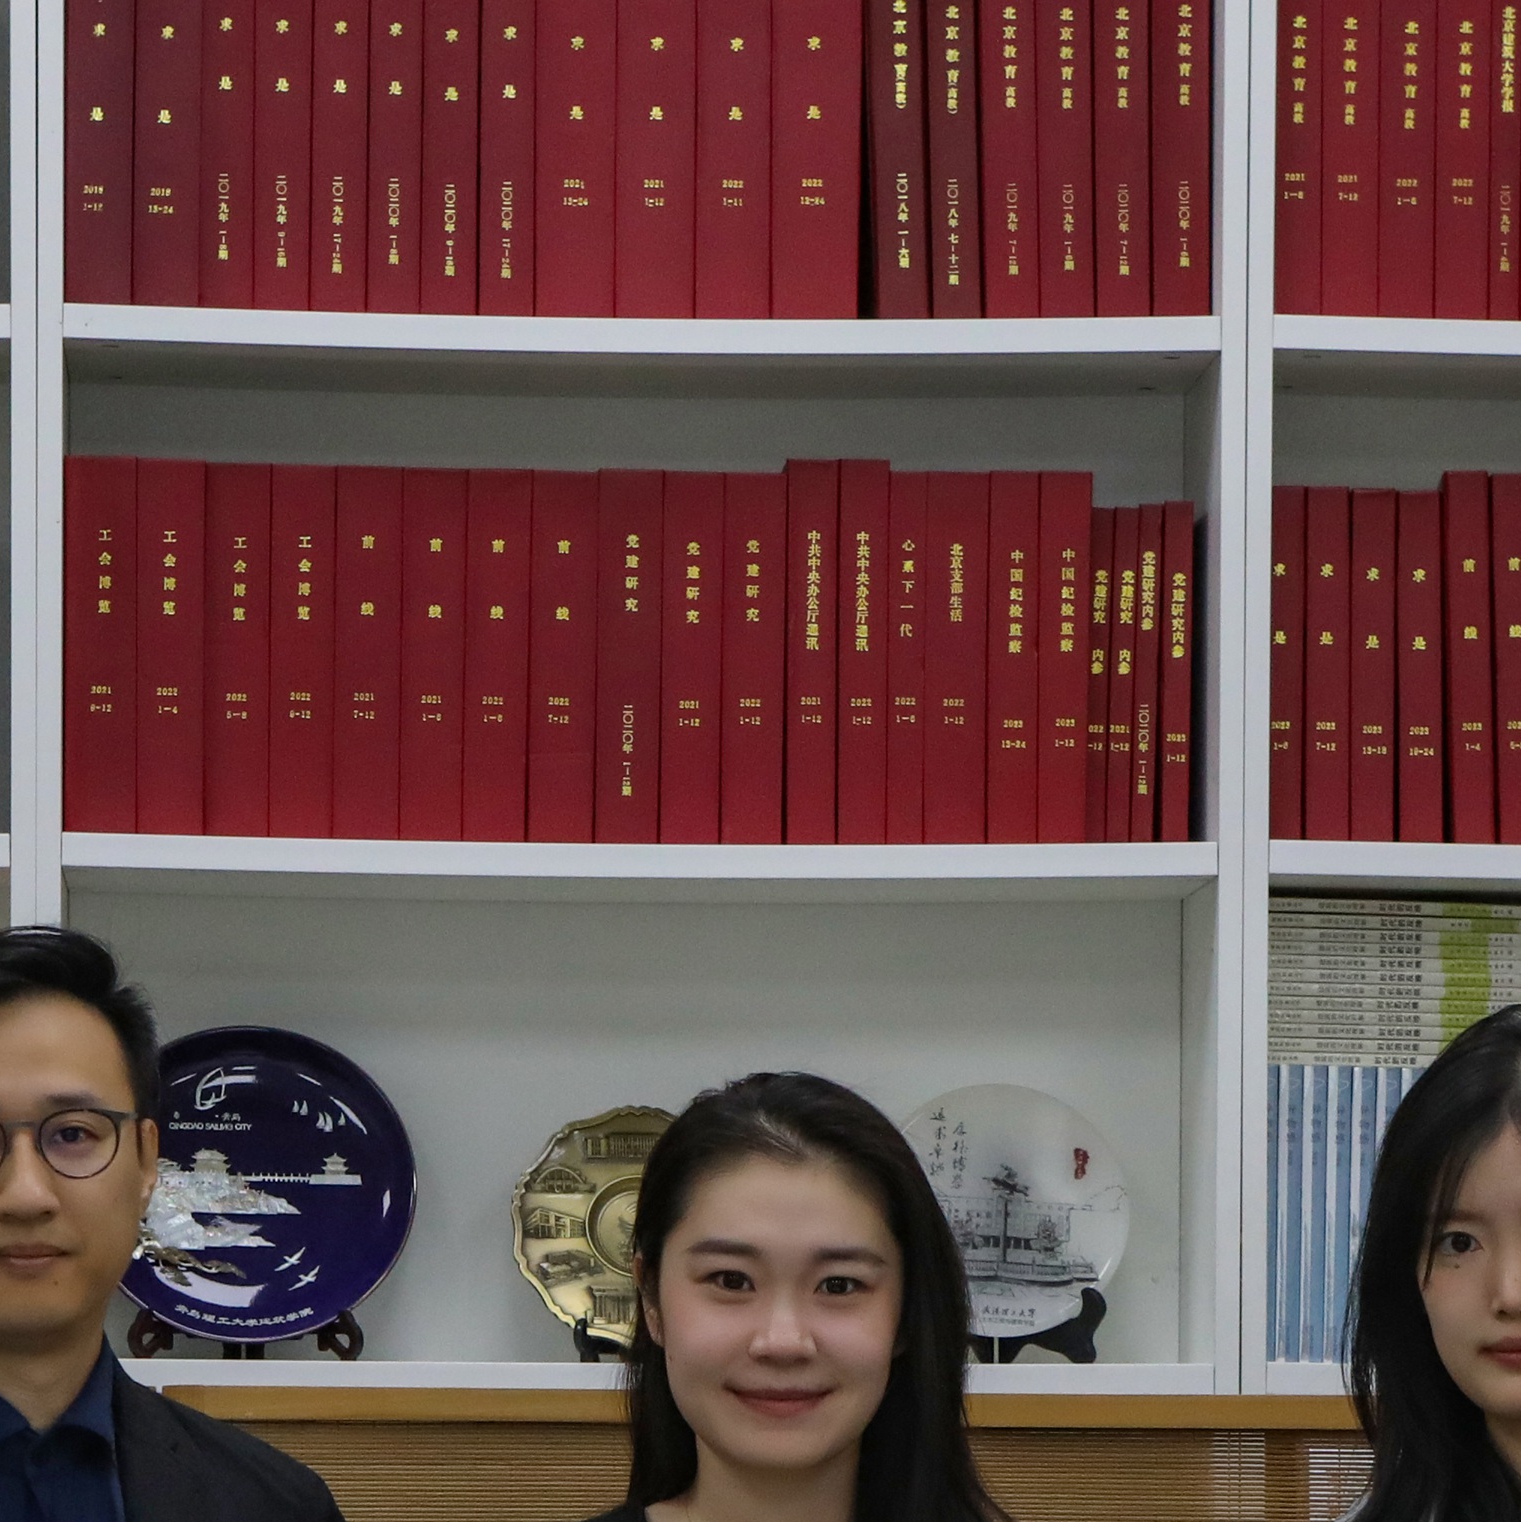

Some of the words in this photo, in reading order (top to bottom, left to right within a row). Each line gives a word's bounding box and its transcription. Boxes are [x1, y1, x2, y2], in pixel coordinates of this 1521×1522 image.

[89, 23, 106, 122] 求是
[157, 25, 175, 124] 求是
[218, 17, 233, 90] 求是
[275, 19, 290, 93] 求是
[502, 25, 517, 99] 求是
[569, 35, 585, 120] 求是
[806, 36, 822, 120] 求是
[801, 178, 823, 188] 2022
[97, 529, 112, 614] 工会博览
[162, 530, 177, 616] 工会博览
[232, 536, 248, 621] 工会博览
[297, 535, 312, 621] 工会博览
[360, 534, 376, 616] 前线
[427, 537, 443, 619] 前线
[489, 538, 506, 620] 前线
[555, 539, 572, 621] 前线
[624, 534, 640, 612] 党建研究
[685, 541, 701, 624] 党建研究
[745, 539, 760, 622] 党建研究
[805, 529, 822, 651] 中共中央办公厅通讯
[855, 530, 871, 652] 中共中央办公厅通讯
[899, 539, 916, 638] 心系下一代
[949, 543, 964, 622] 北京支部生活
[1008, 549, 1024, 654] 中国纪检监察
[1060, 547, 1076, 653] 中国纪检监察
[1140, 550, 1156, 631] 党建研究内参
[1272, 562, 1287, 645] 求是
[1319, 563, 1334, 646] 求是
[1365, 567, 1380, 650] 求是
[1412, 568, 1427, 651] 求是
[1170, 572, 1187, 659] 党建研究内参
[90, 685, 112, 695] 2021
[156, 687, 178, 697] 2022
[225, 692, 248, 702] 2022
[289, 691, 311, 702] 2022
[353, 692, 375, 702] 2021
[548, 696, 570, 706] 2022
[678, 700, 699, 710] 2021
[894, 696, 916, 706] 2022
[942, 698, 965, 707] 2022
[1003, 719, 1024, 729] 2023
[169, 1121, 204, 1131] QINGDAO
[235, 1122, 252, 1131] CITY
